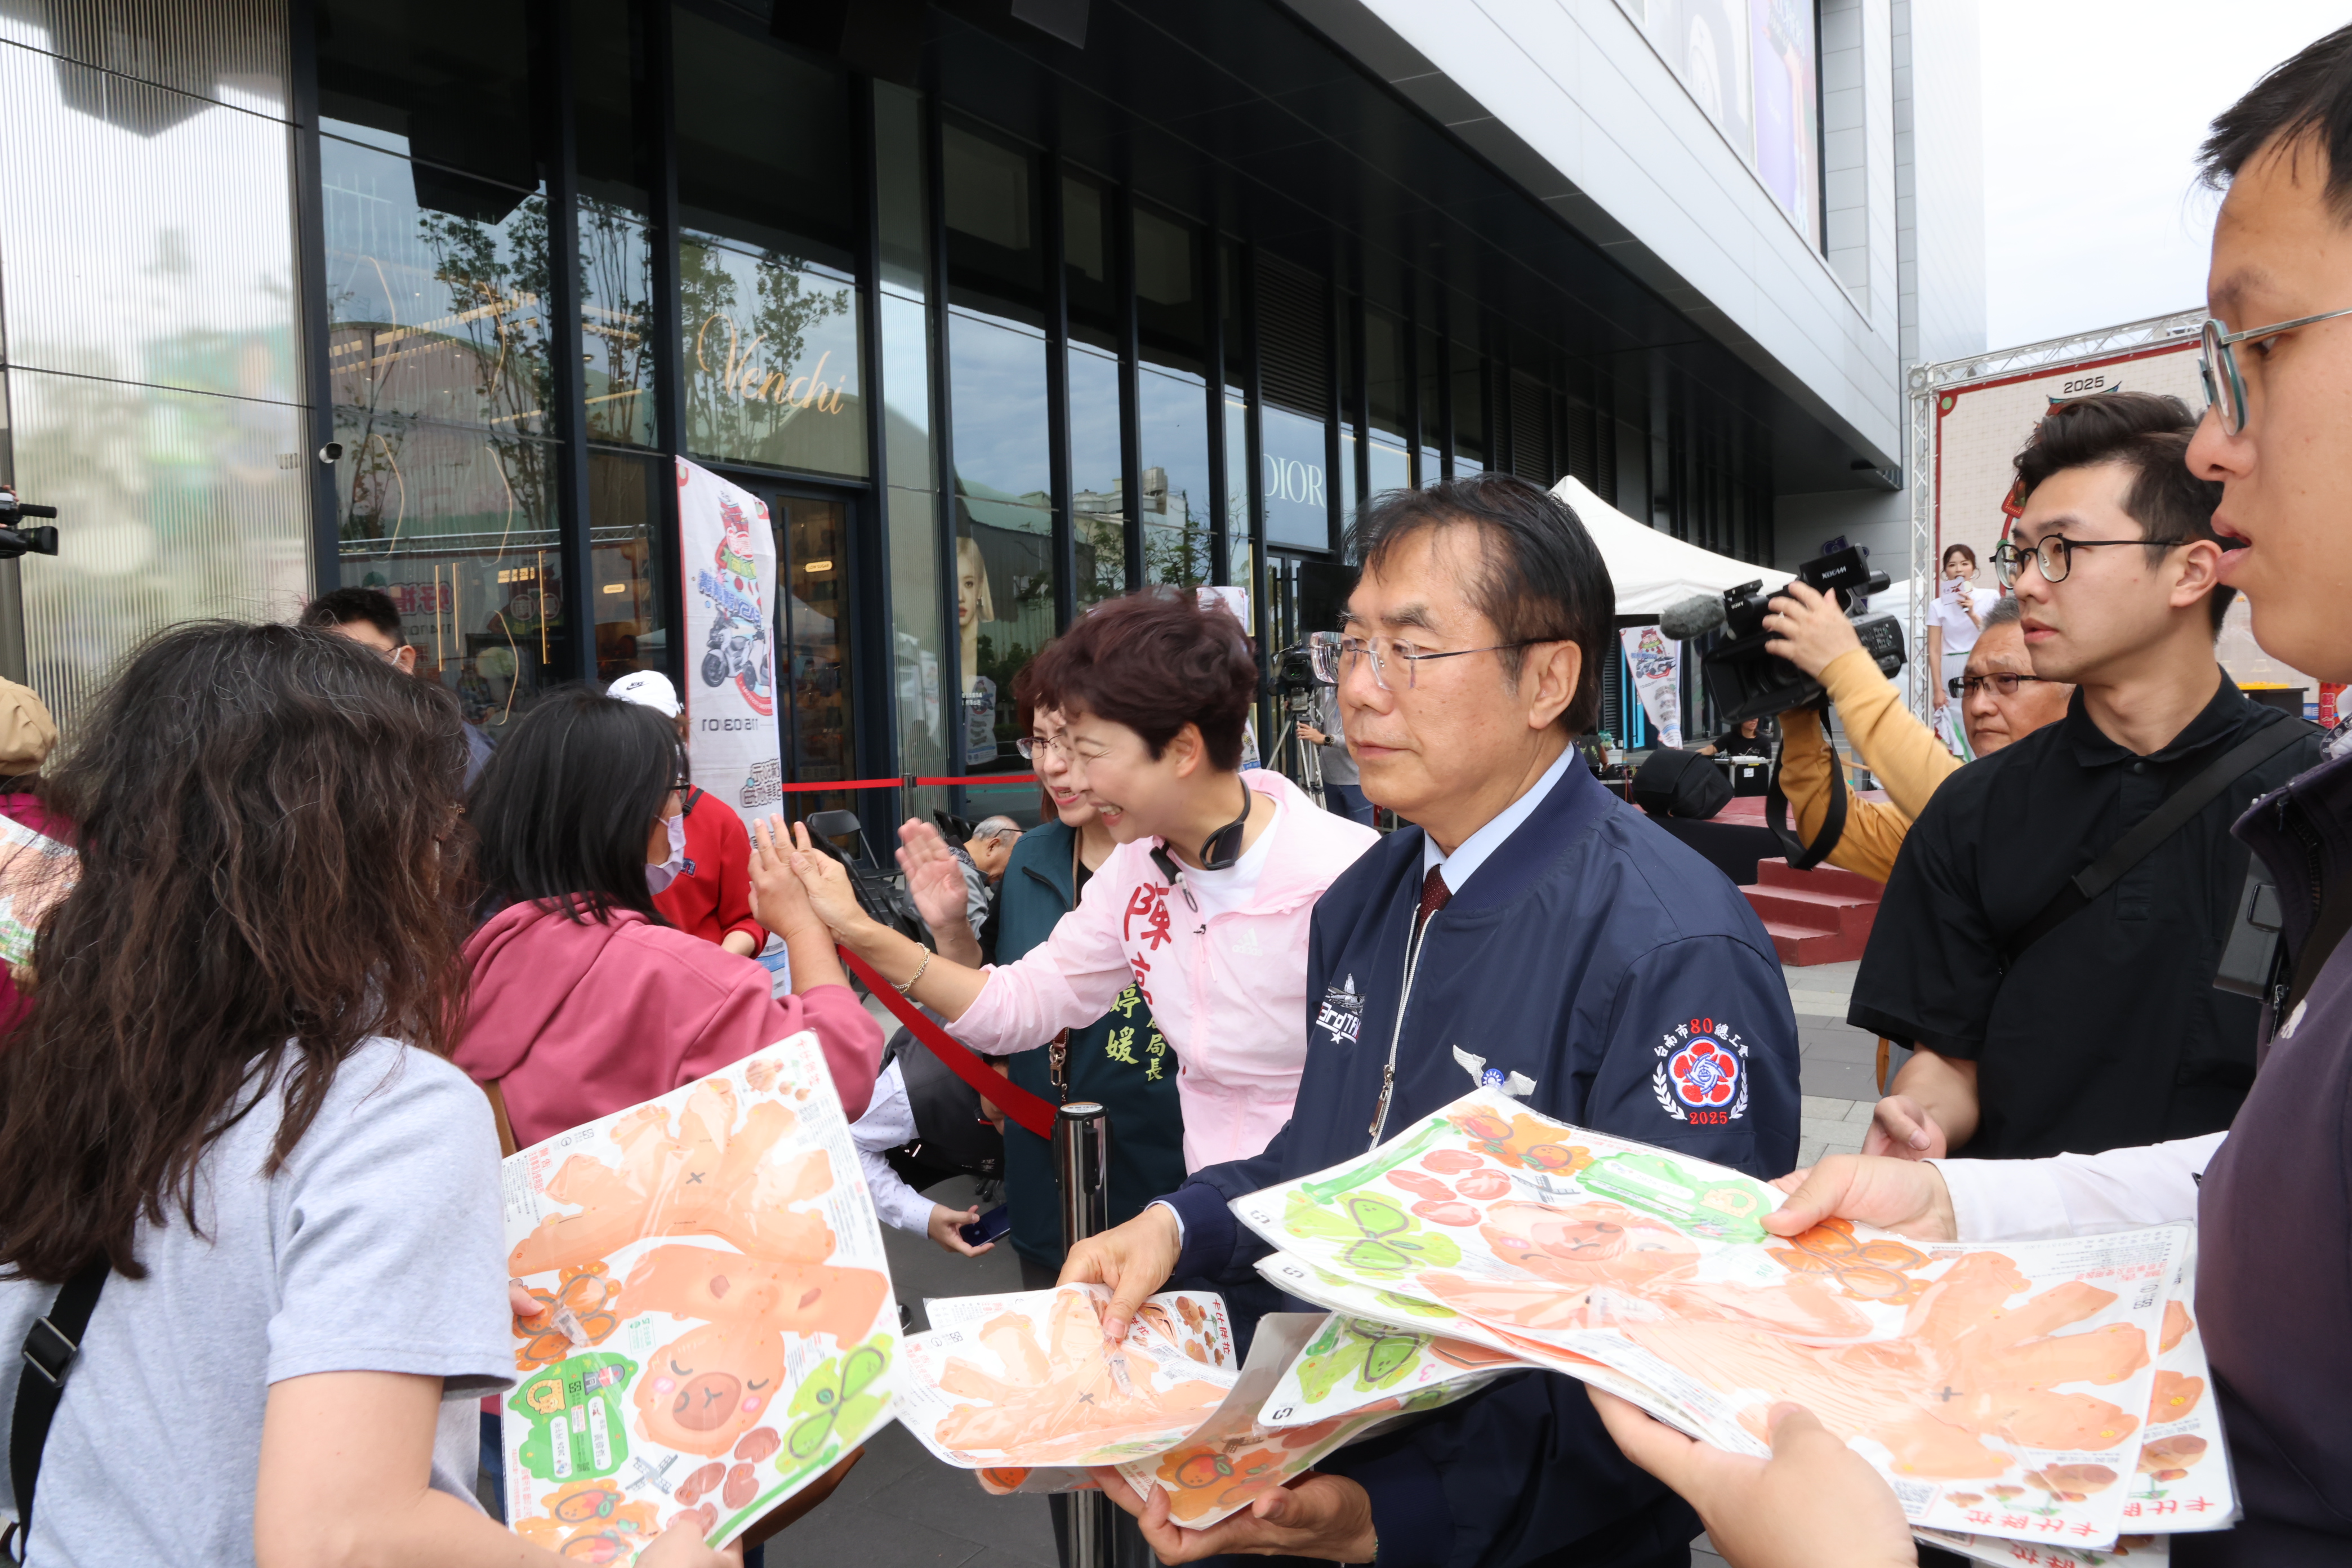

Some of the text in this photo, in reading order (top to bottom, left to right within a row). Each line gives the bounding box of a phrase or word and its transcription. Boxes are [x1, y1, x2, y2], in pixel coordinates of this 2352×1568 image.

[696, 313, 847, 415] Venchi
[2064, 375, 2105, 394] 2025
[1263, 453, 1326, 508] DIOR
[1731, 600, 1744, 610] SONY
[1232, 944, 1263, 957] adidas
[1145, 1015, 1168, 1082] 局長
[1689, 1111, 1729, 1125] 2025
[1211, 1299, 1231, 1355] 卡比胖拉
